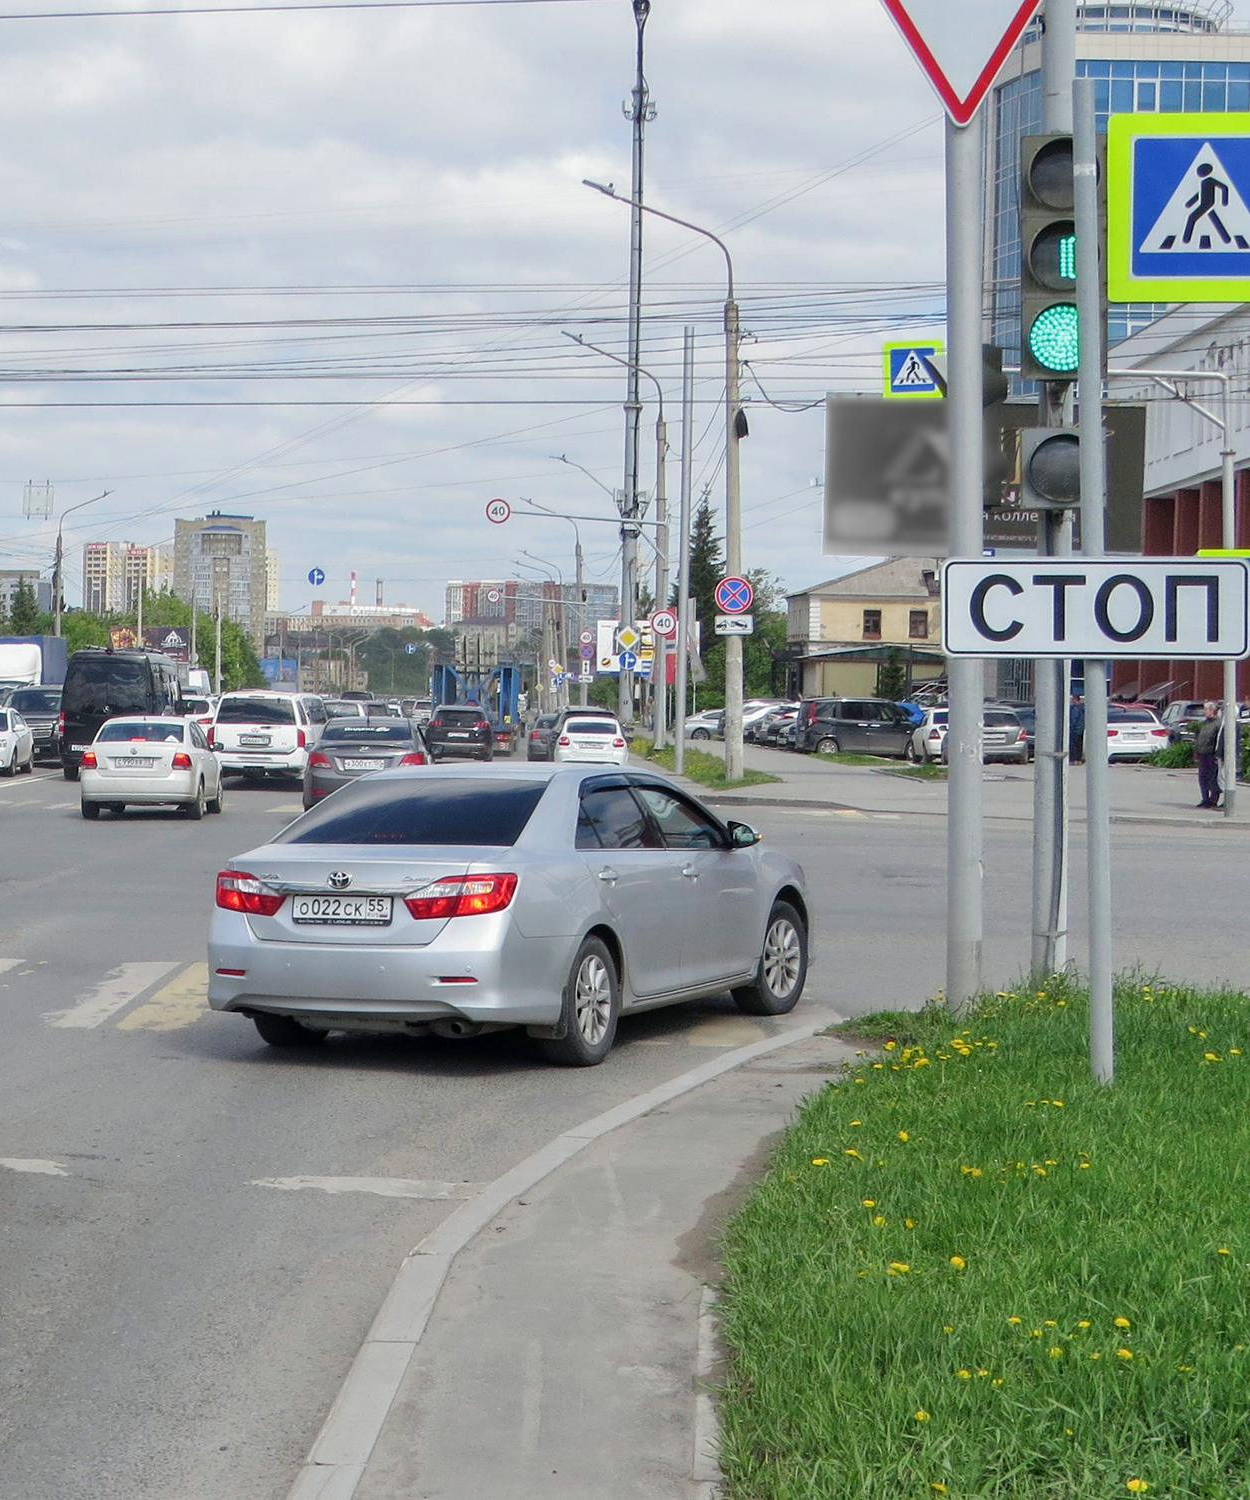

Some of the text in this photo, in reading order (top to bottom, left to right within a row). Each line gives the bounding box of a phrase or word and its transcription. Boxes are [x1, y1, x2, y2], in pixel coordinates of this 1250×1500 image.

[491, 506, 505, 516] 40
[969, 573, 1219, 643] СТОП
[656, 618, 671, 629] 40
[299, 898, 385, 916] О022СК 55
